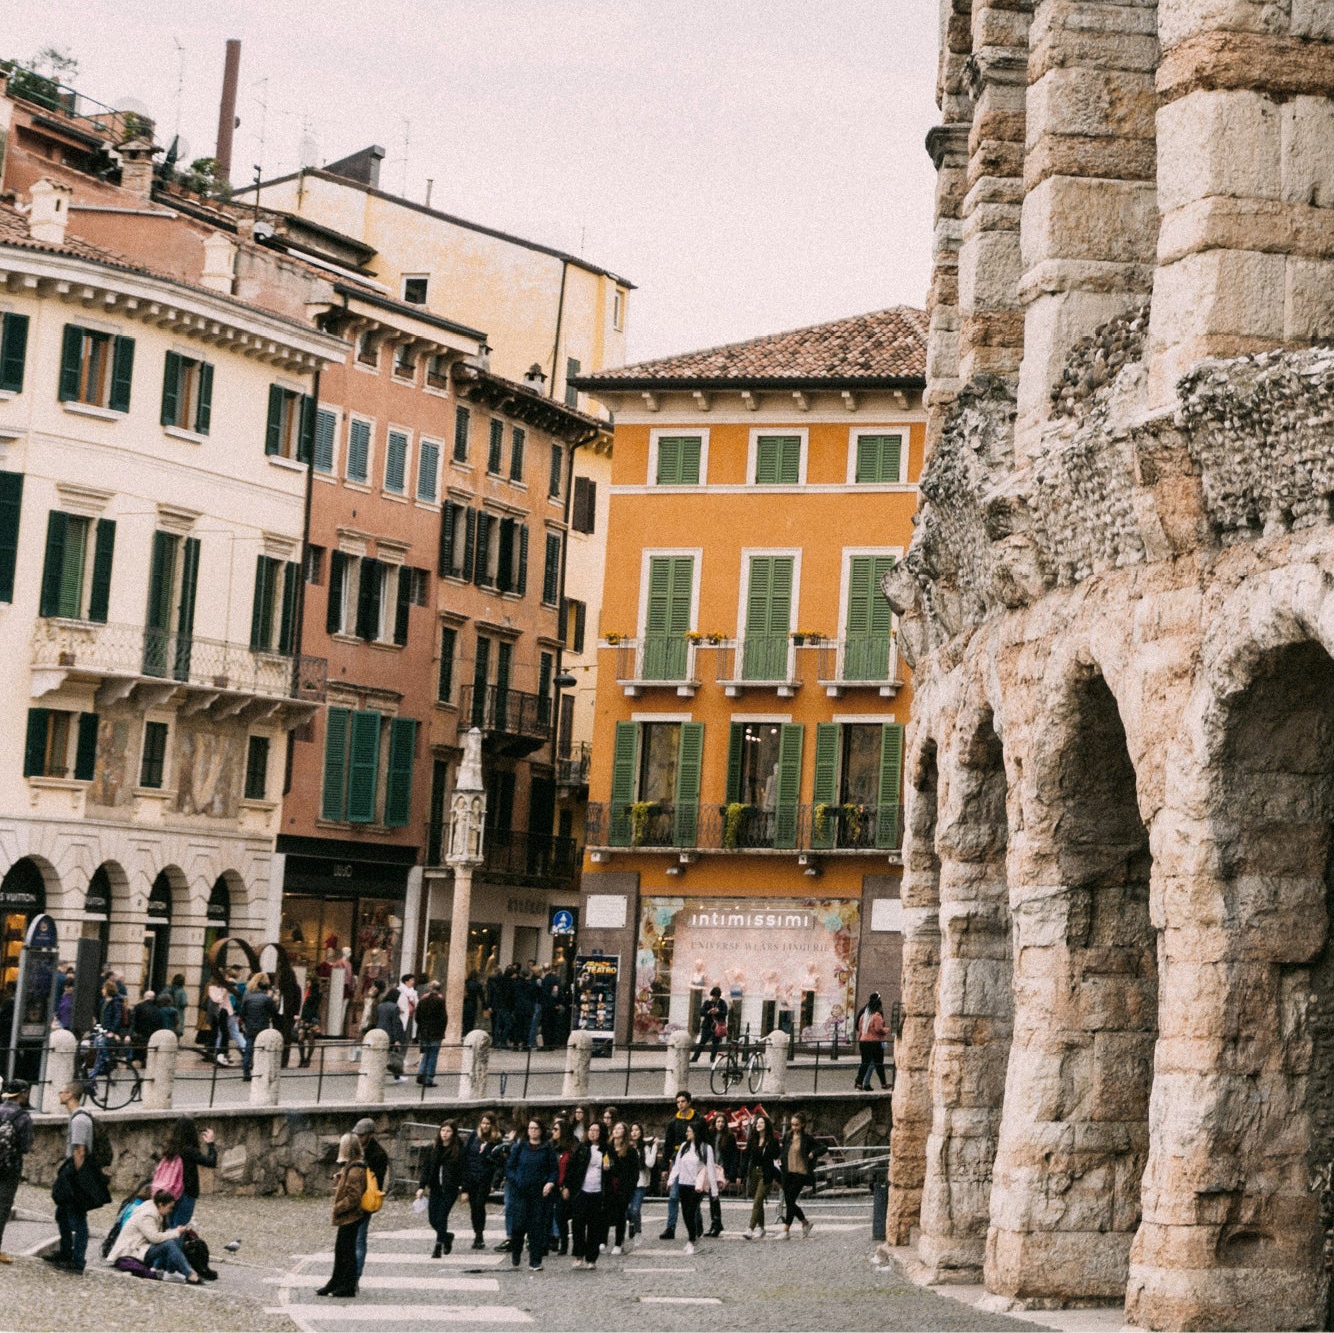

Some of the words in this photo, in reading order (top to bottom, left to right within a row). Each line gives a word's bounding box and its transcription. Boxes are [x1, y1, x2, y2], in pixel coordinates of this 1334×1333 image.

[692, 912, 808, 927] intimissimi
[691, 941, 739, 950] UNIVERSE
[745, 942, 779, 951] WEARS
[783, 942, 829, 952] LINGERIE
[586, 966, 617, 975] TEATRO
